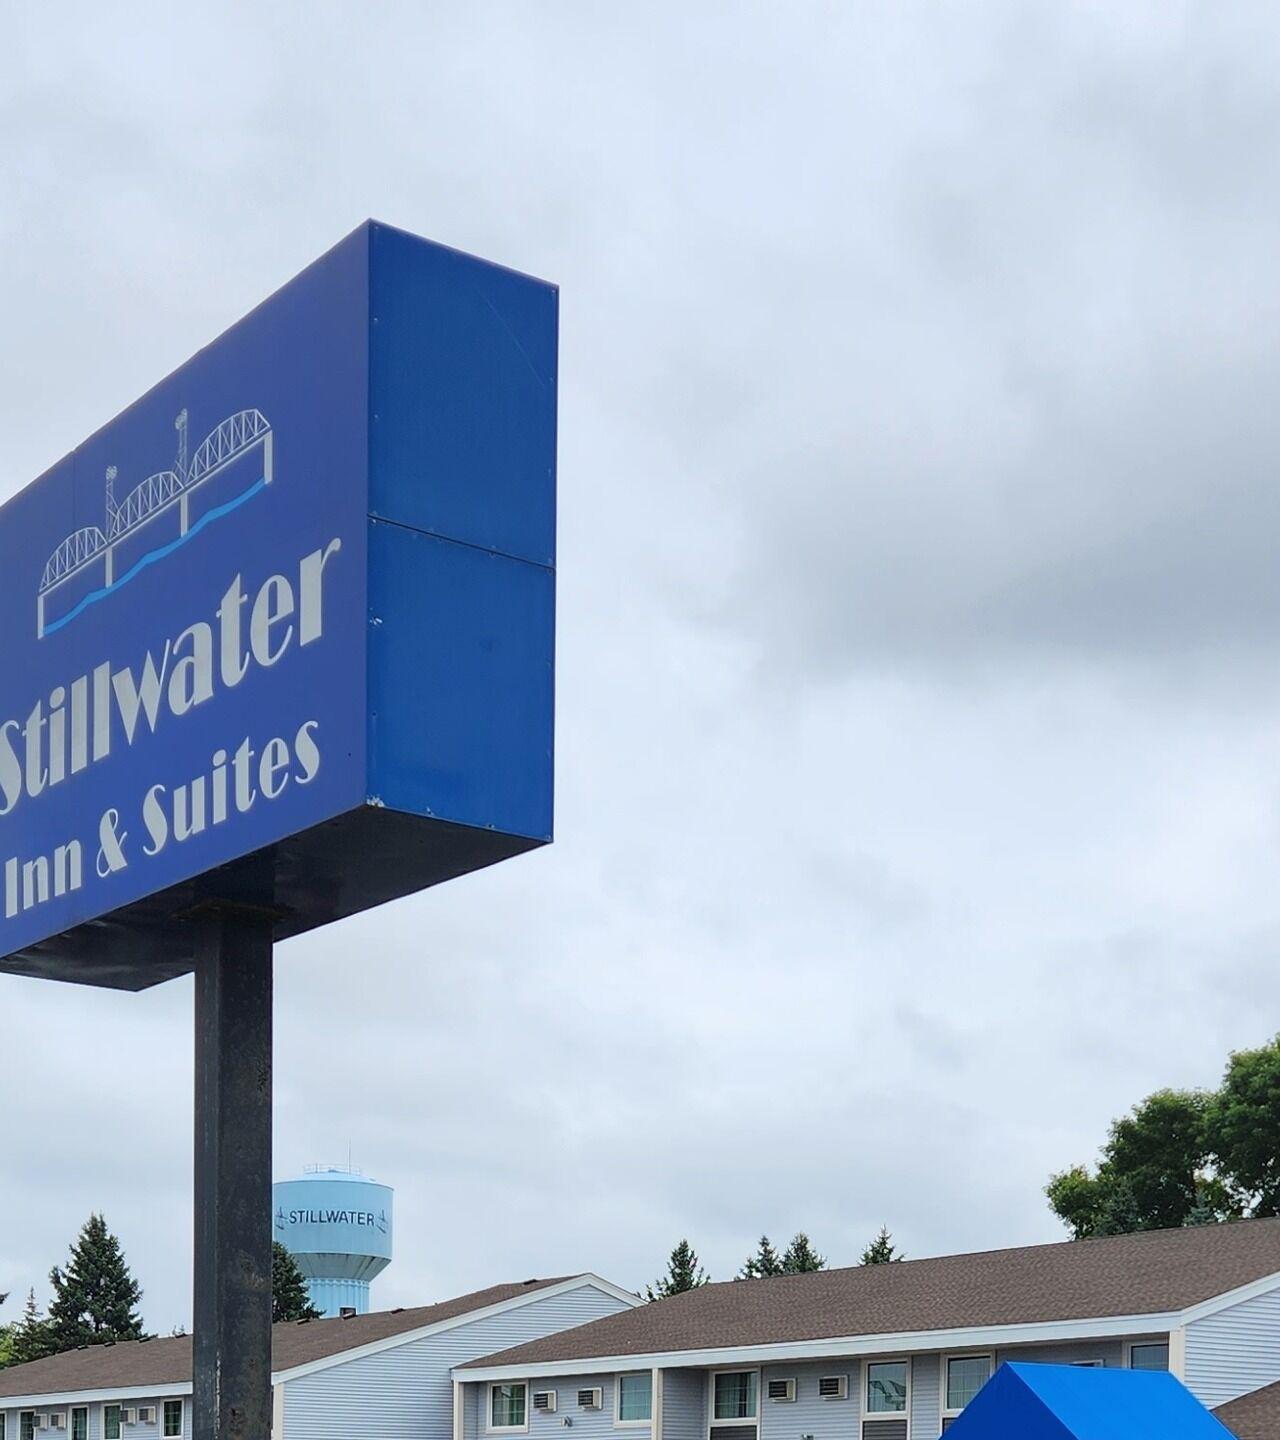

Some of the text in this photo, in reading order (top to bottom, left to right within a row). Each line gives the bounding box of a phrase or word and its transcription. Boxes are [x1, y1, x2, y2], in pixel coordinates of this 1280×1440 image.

[5, 720, 320, 919] Inn & Suites
[288, 1210, 375, 1226] STILLWATER
